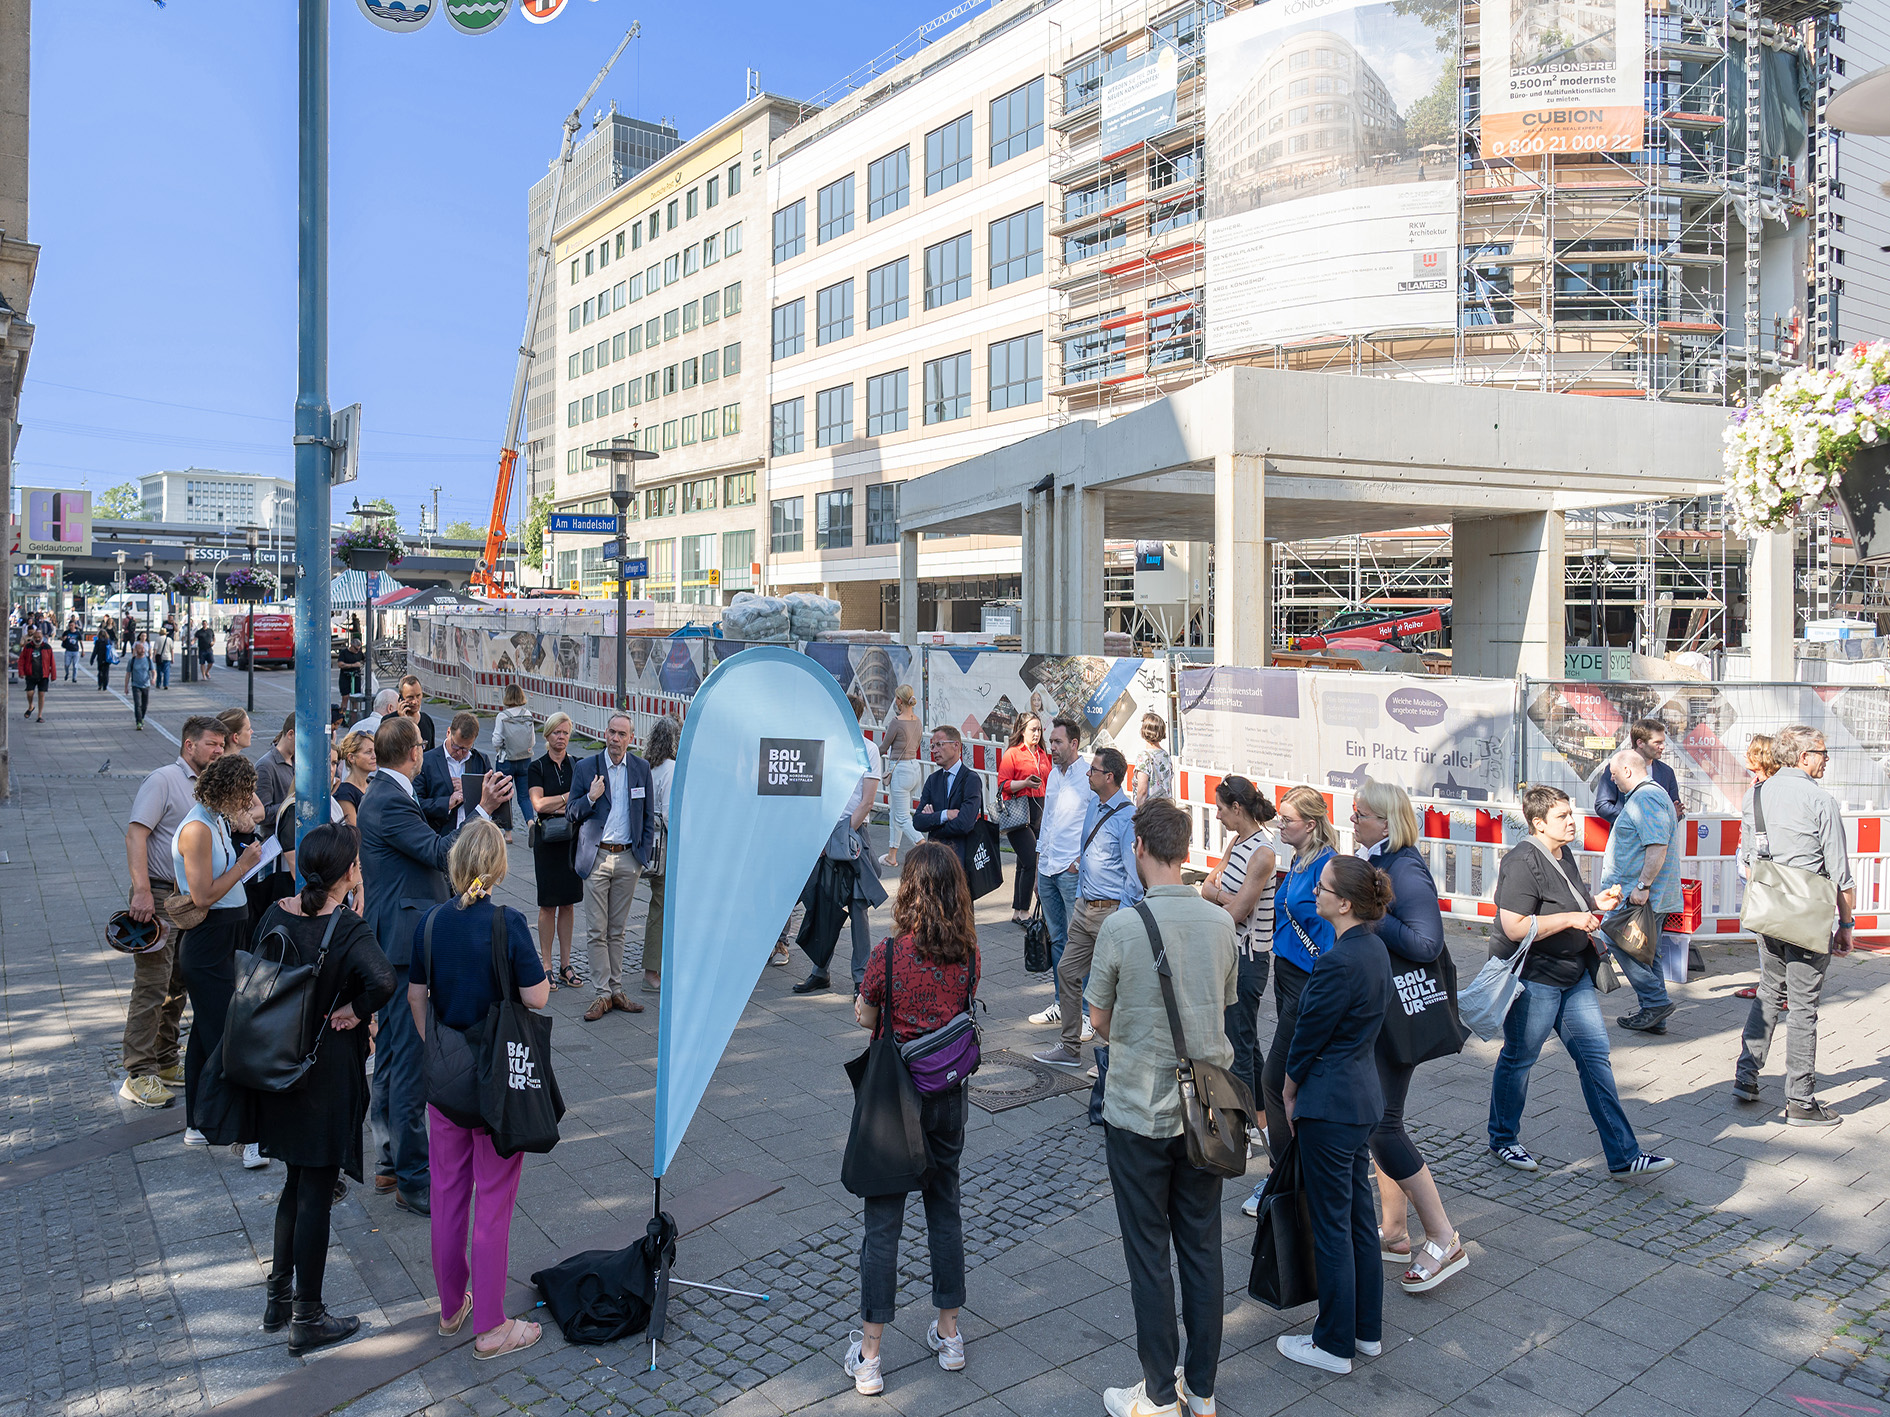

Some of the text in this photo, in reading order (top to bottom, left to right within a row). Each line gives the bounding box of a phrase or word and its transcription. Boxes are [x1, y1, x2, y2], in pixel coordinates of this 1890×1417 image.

[1510, 61, 1616, 76] PROVISIONSFREI
[1560, 75, 1616, 86] modernste
[1510, 91, 1528, 99] Büro-
[1544, 87, 1616, 96] Multifunktionsflächen
[1522, 109, 1603, 126] CUBION
[1492, 134, 1632, 156] 0 800 21 000 22
[1409, 229, 1447, 237] Architektur
[1408, 280, 1447, 290] LAMERS
[556, 519, 614, 530] Am Handelshof
[28, 543, 83, 553] Geldautomat
[194, 549, 229, 560] ESSEN
[1392, 697, 1444, 708] Welche Mobilitäts-
[1575, 695, 1601, 705] 3.200
[1086, 706, 1103, 714] 3.200
[1392, 708, 1439, 716] angebote fehlen?
[1690, 736, 1715, 746] 5.400
[769, 749, 800, 761] BAU
[1346, 740, 1473, 769] Ein Platz für alle!
[769, 761, 806, 773] KULT
[768, 773, 789, 785] UR
[1291, 920, 1313, 949] CALVIN
[1393, 968, 1427, 990] BAU
[1397, 979, 1437, 1003] KULT
[1402, 998, 1426, 1016] UR
[507, 1042, 530, 1061] BAU
[508, 1072, 526, 1090] UR
